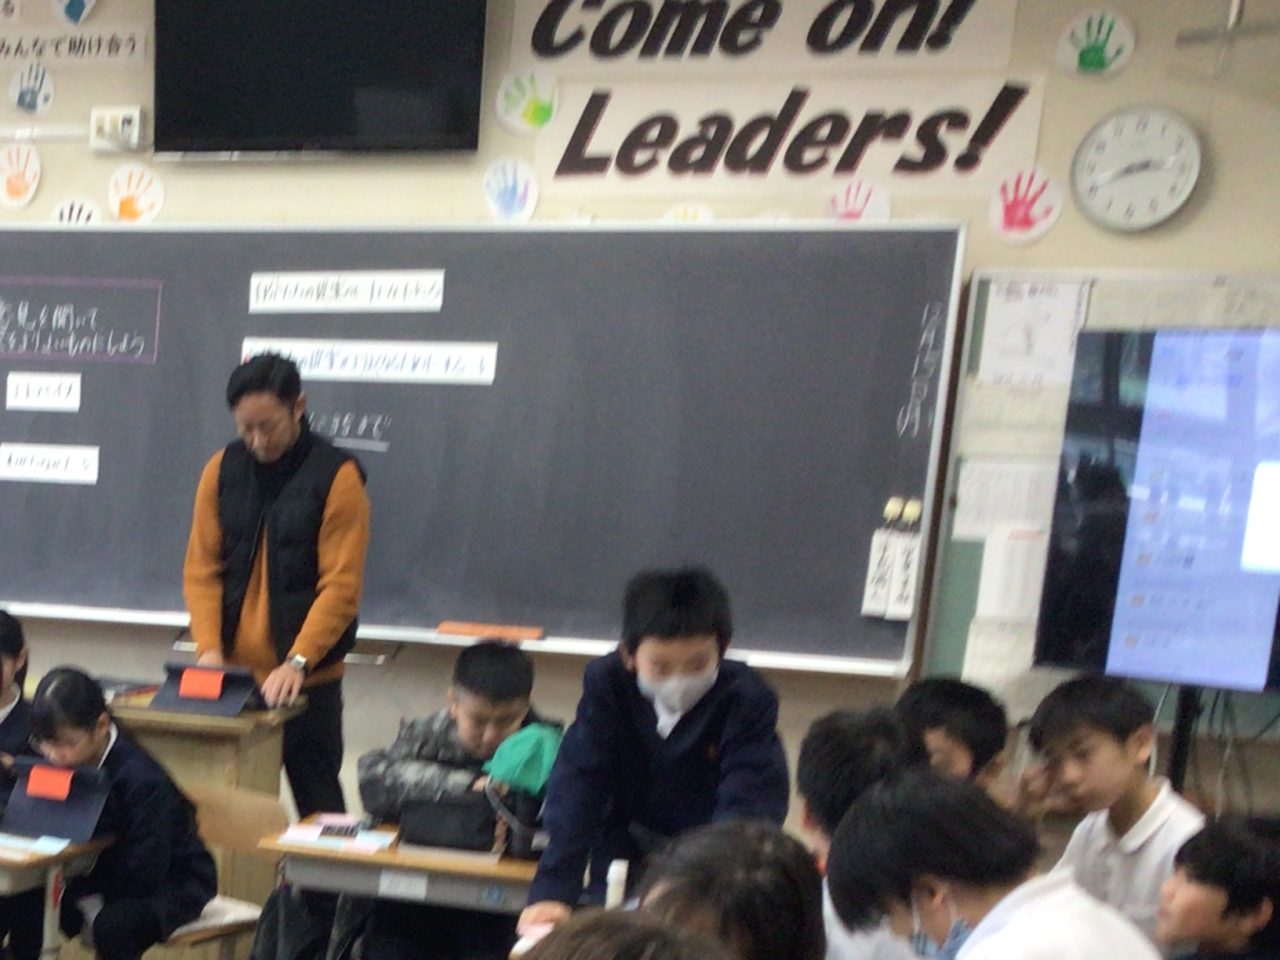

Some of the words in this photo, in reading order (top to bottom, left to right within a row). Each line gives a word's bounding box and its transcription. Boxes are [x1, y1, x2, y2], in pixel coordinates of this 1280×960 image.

[530, 0, 782, 60] Come
[807, 0, 980, 55] on!
[554, 83, 1030, 179] Leaders!
